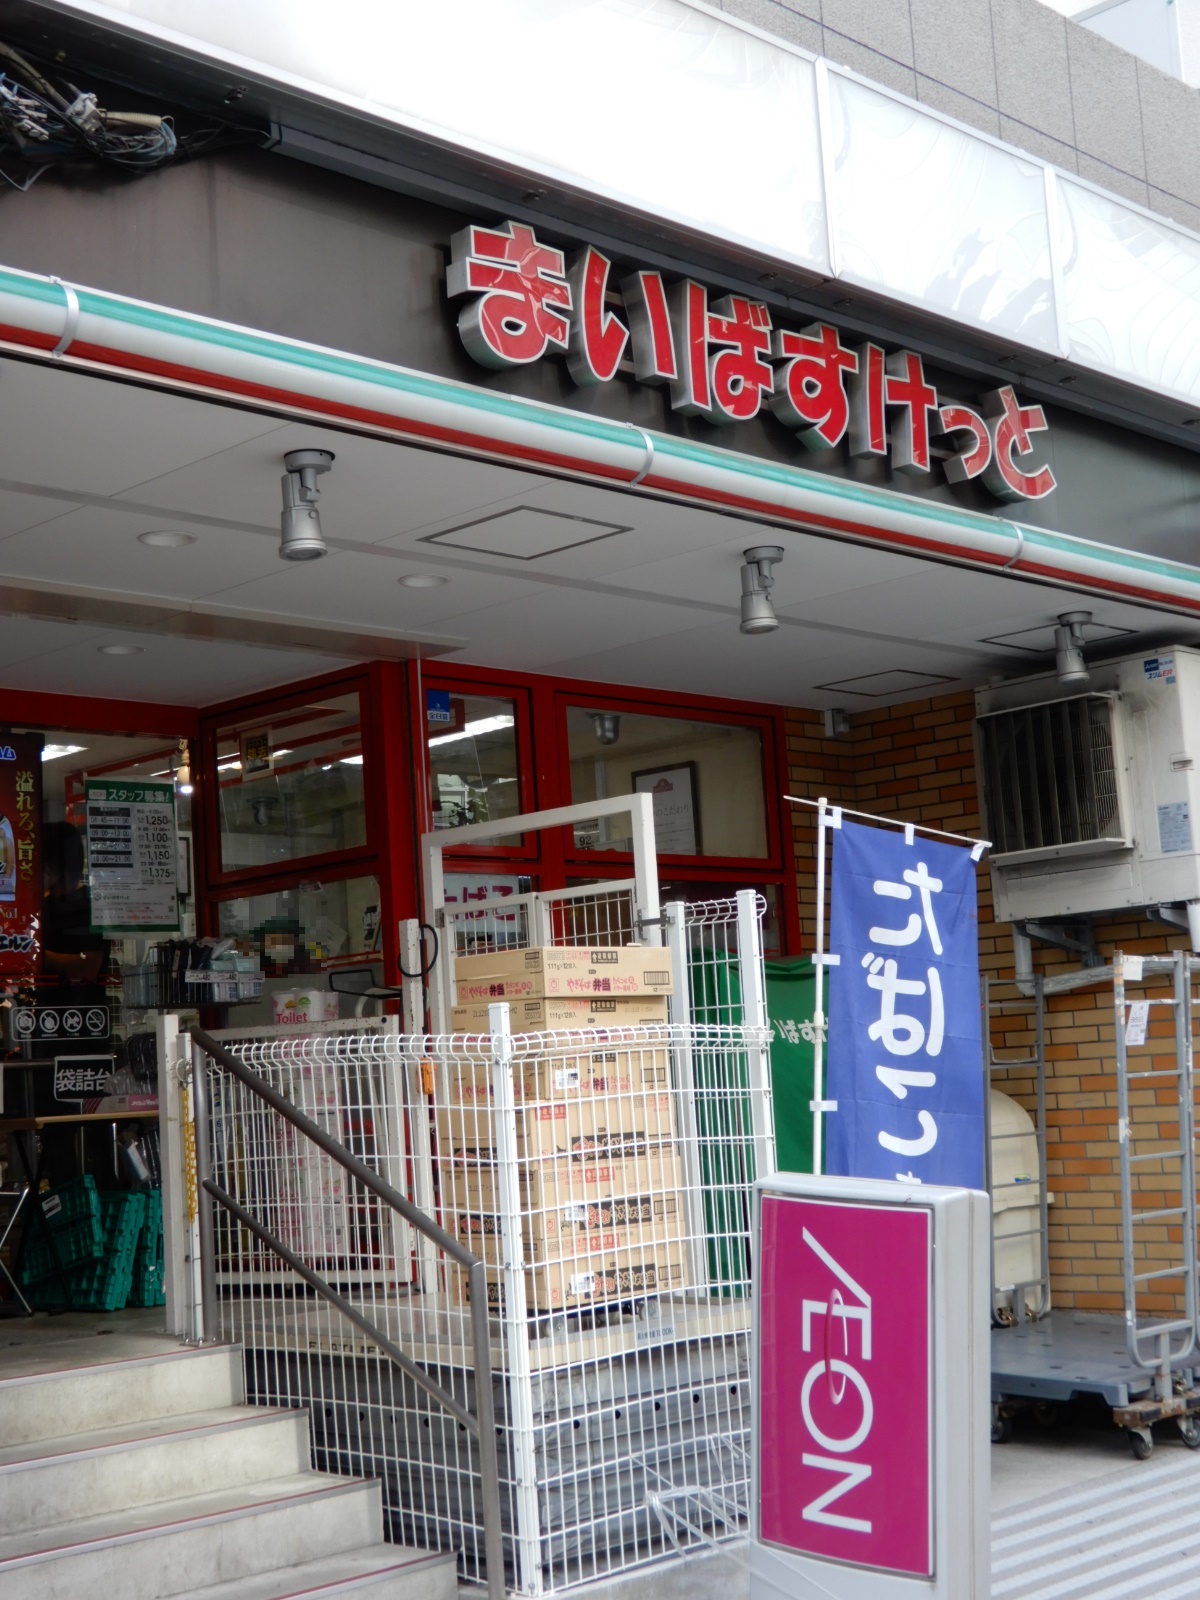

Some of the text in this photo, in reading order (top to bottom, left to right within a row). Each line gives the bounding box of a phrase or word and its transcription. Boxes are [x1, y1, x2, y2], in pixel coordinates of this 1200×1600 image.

[447, 220, 1057, 500] まいばすけっと
[276, 1012, 308, 1025] Toilet
[801, 1226, 873, 1534] AEON
